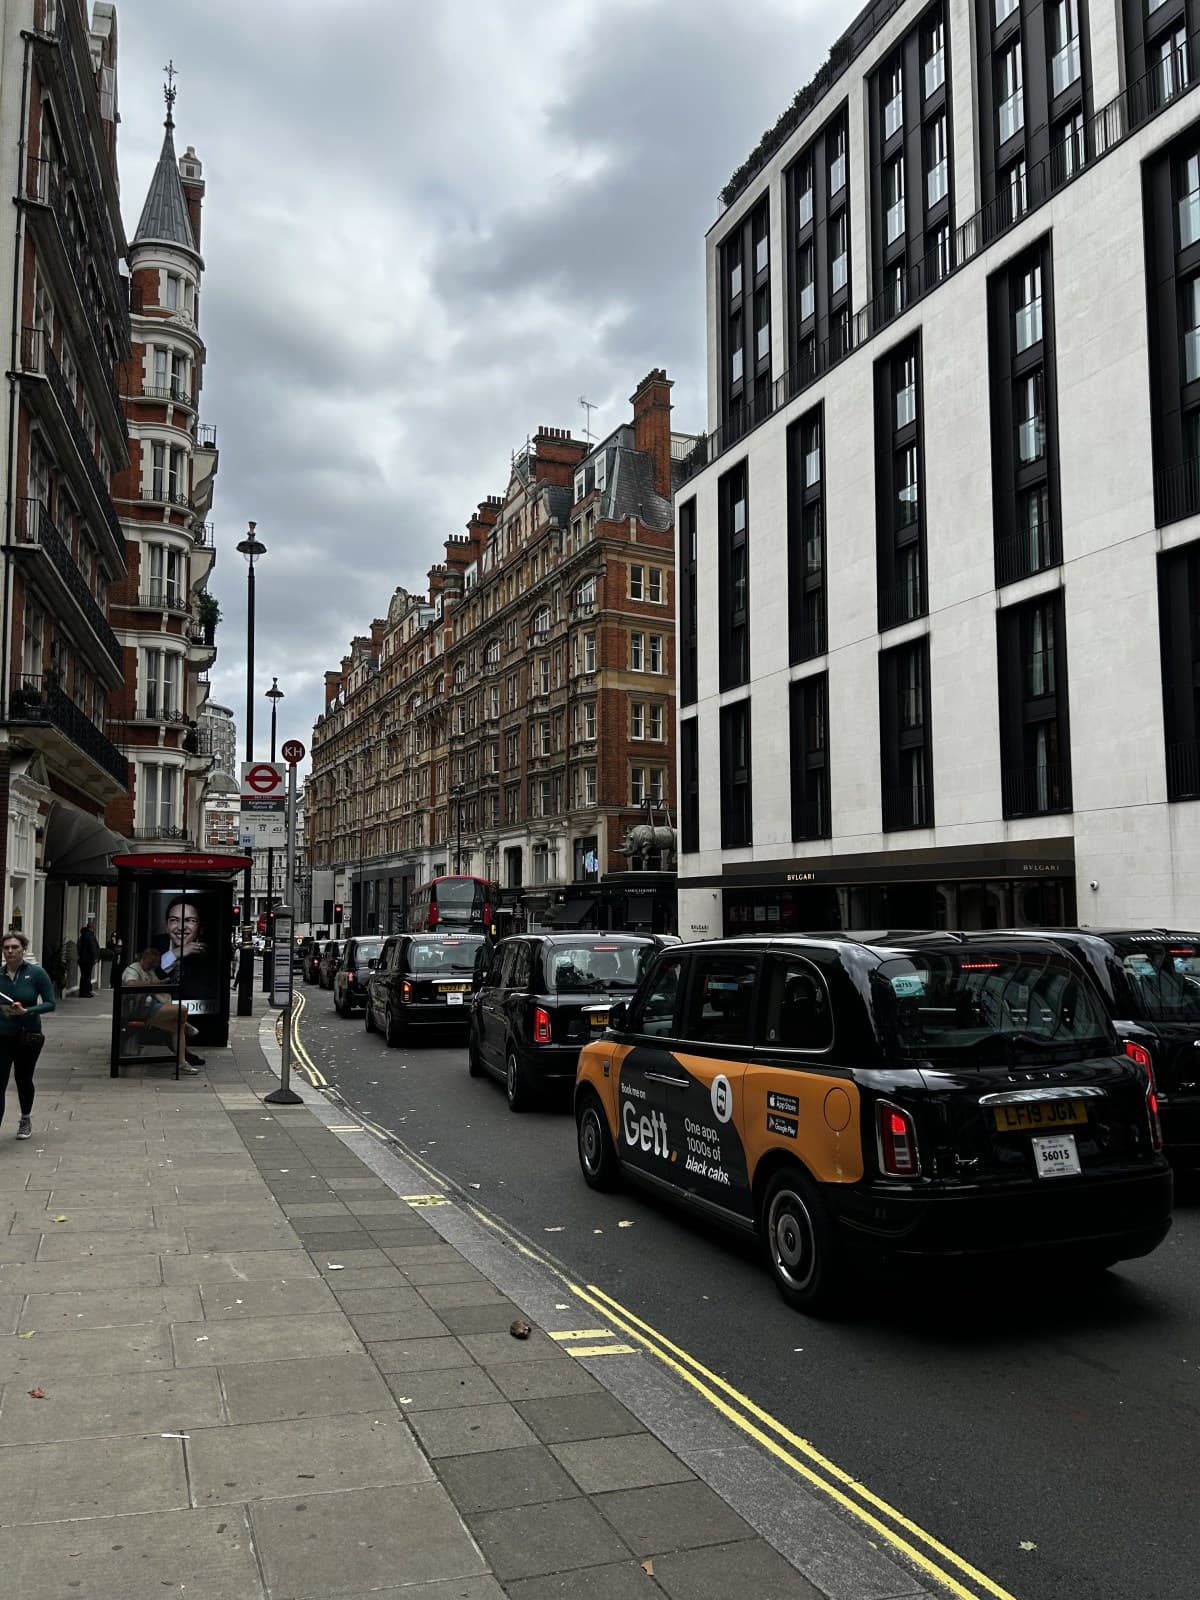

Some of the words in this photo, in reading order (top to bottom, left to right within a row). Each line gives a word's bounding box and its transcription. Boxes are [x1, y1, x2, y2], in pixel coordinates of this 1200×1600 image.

[284, 746, 303, 757] KH
[786, 873, 815, 881] BVLGARI
[621, 1082, 633, 1094] Book
[639, 1090, 647, 1099] on
[1004, 1103, 1042, 1126] LF19
[684, 1117, 701, 1136] One
[701, 1125, 720, 1144] app.
[686, 1136, 712, 1159] 1000s
[712, 1146, 721, 1162] of
[1041, 1149, 1070, 1162] 56015
[685, 1154, 707, 1177] black
[707, 1166, 731, 1186] cabs.
